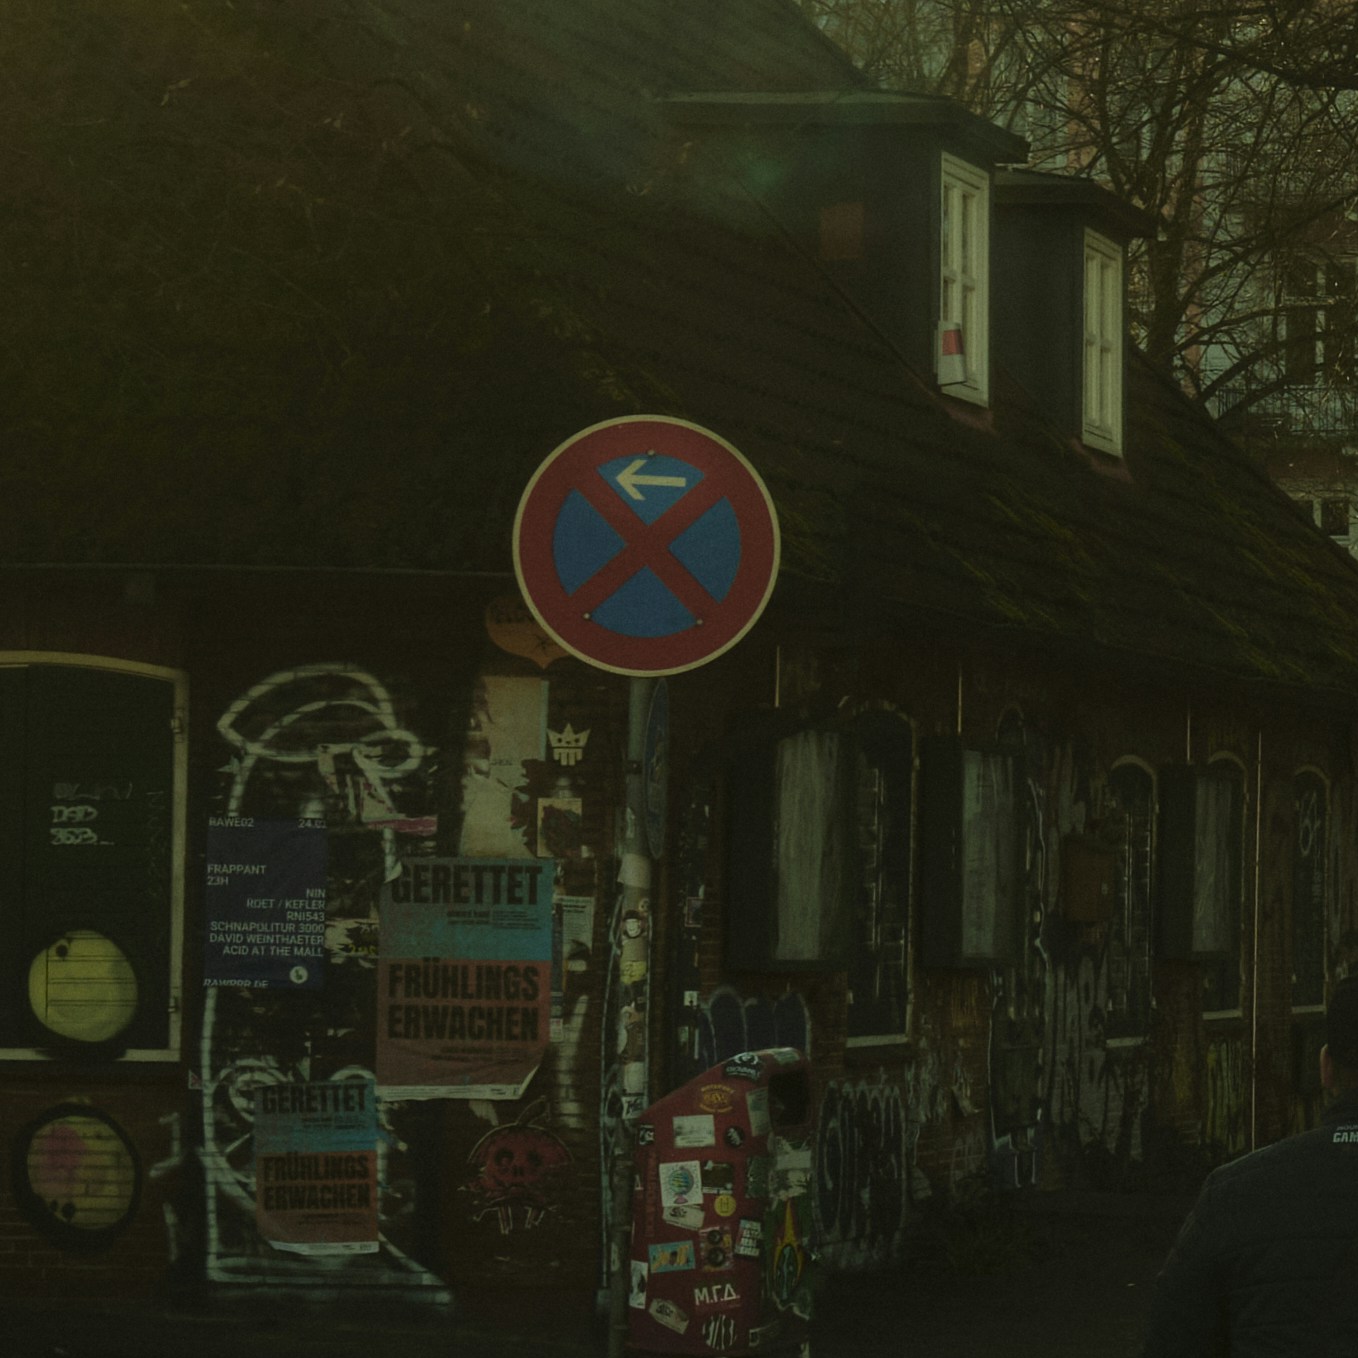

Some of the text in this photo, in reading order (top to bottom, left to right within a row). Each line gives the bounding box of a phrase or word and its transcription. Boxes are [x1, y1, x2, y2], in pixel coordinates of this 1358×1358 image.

[207, 863, 267, 875] FRAPPANT
[391, 864, 543, 905] GERETTET
[209, 932, 244, 944] DAVID
[223, 944, 249, 956] ACID
[270, 945, 292, 957] THE
[388, 956, 540, 1001] FRÜHLINGS
[387, 1003, 540, 1041] ERWACHEN
[262, 1083, 369, 1115] GERETTET
[263, 1150, 370, 1182] FRÜHLINGS
[263, 1182, 371, 1212] ERWACHEN
